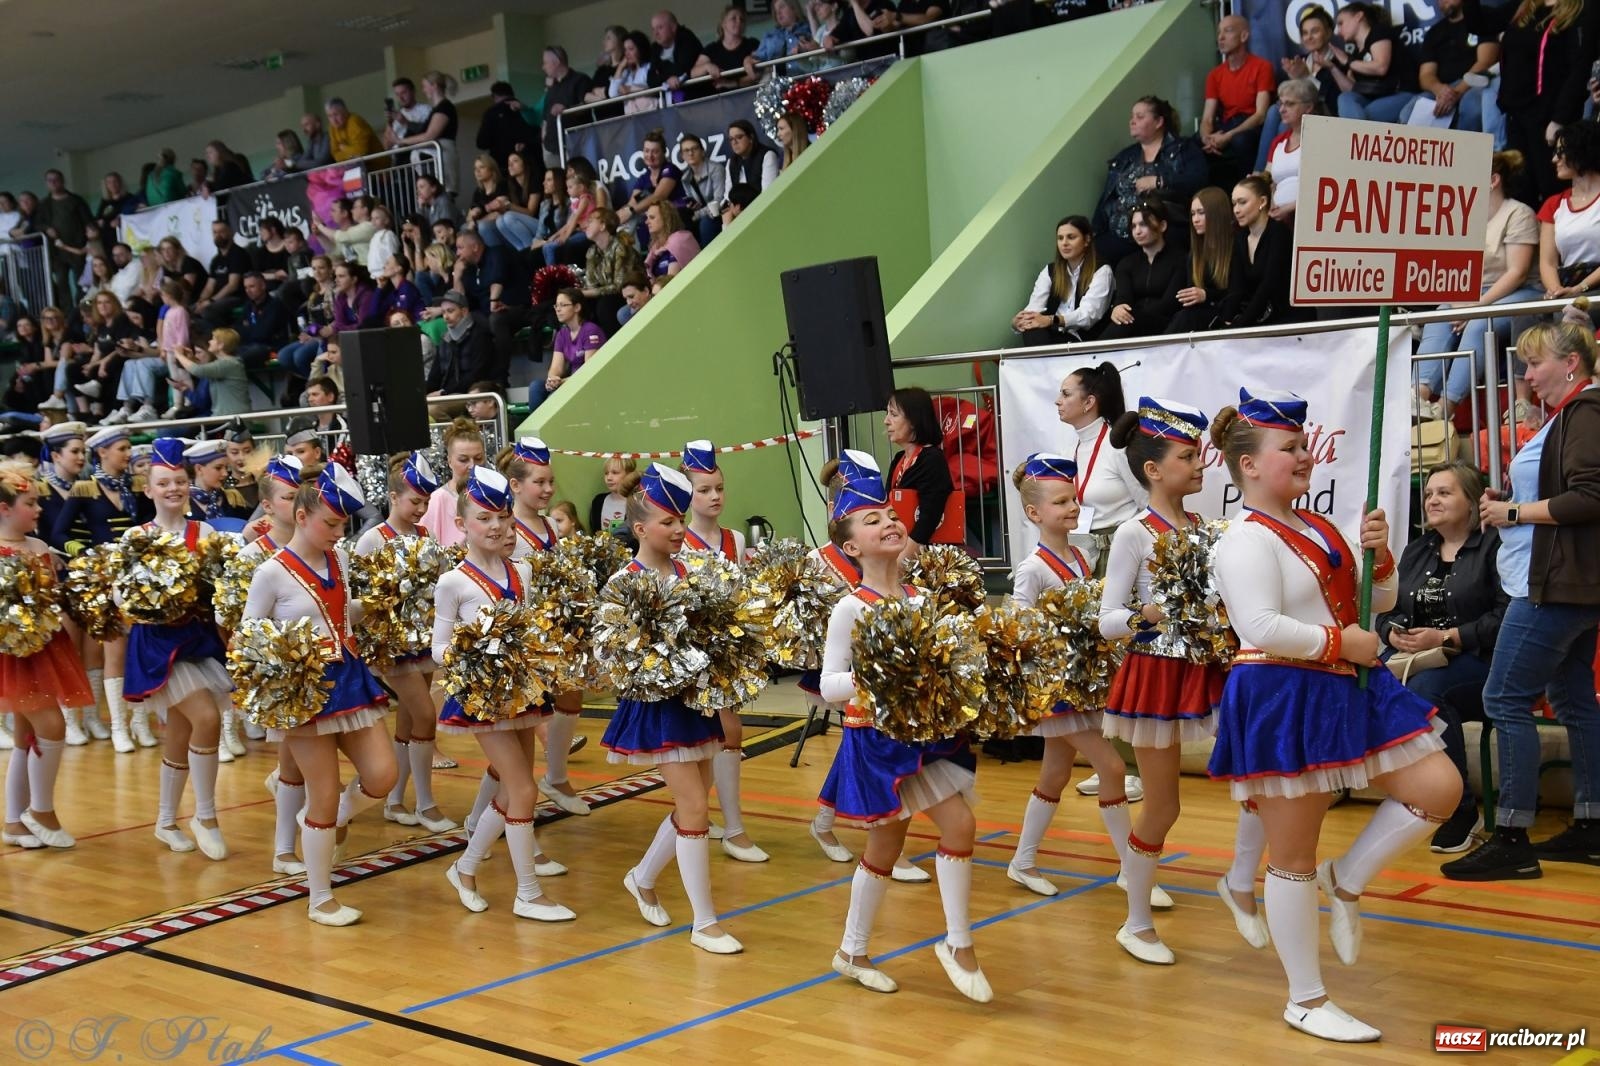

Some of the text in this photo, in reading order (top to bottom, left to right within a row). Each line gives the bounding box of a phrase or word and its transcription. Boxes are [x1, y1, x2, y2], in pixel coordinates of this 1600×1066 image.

[1350, 130, 1455, 168] MAŻORETKI
[1315, 177, 1478, 237] PANTERY
[1306, 258, 1472, 294] Gliwice Poland
